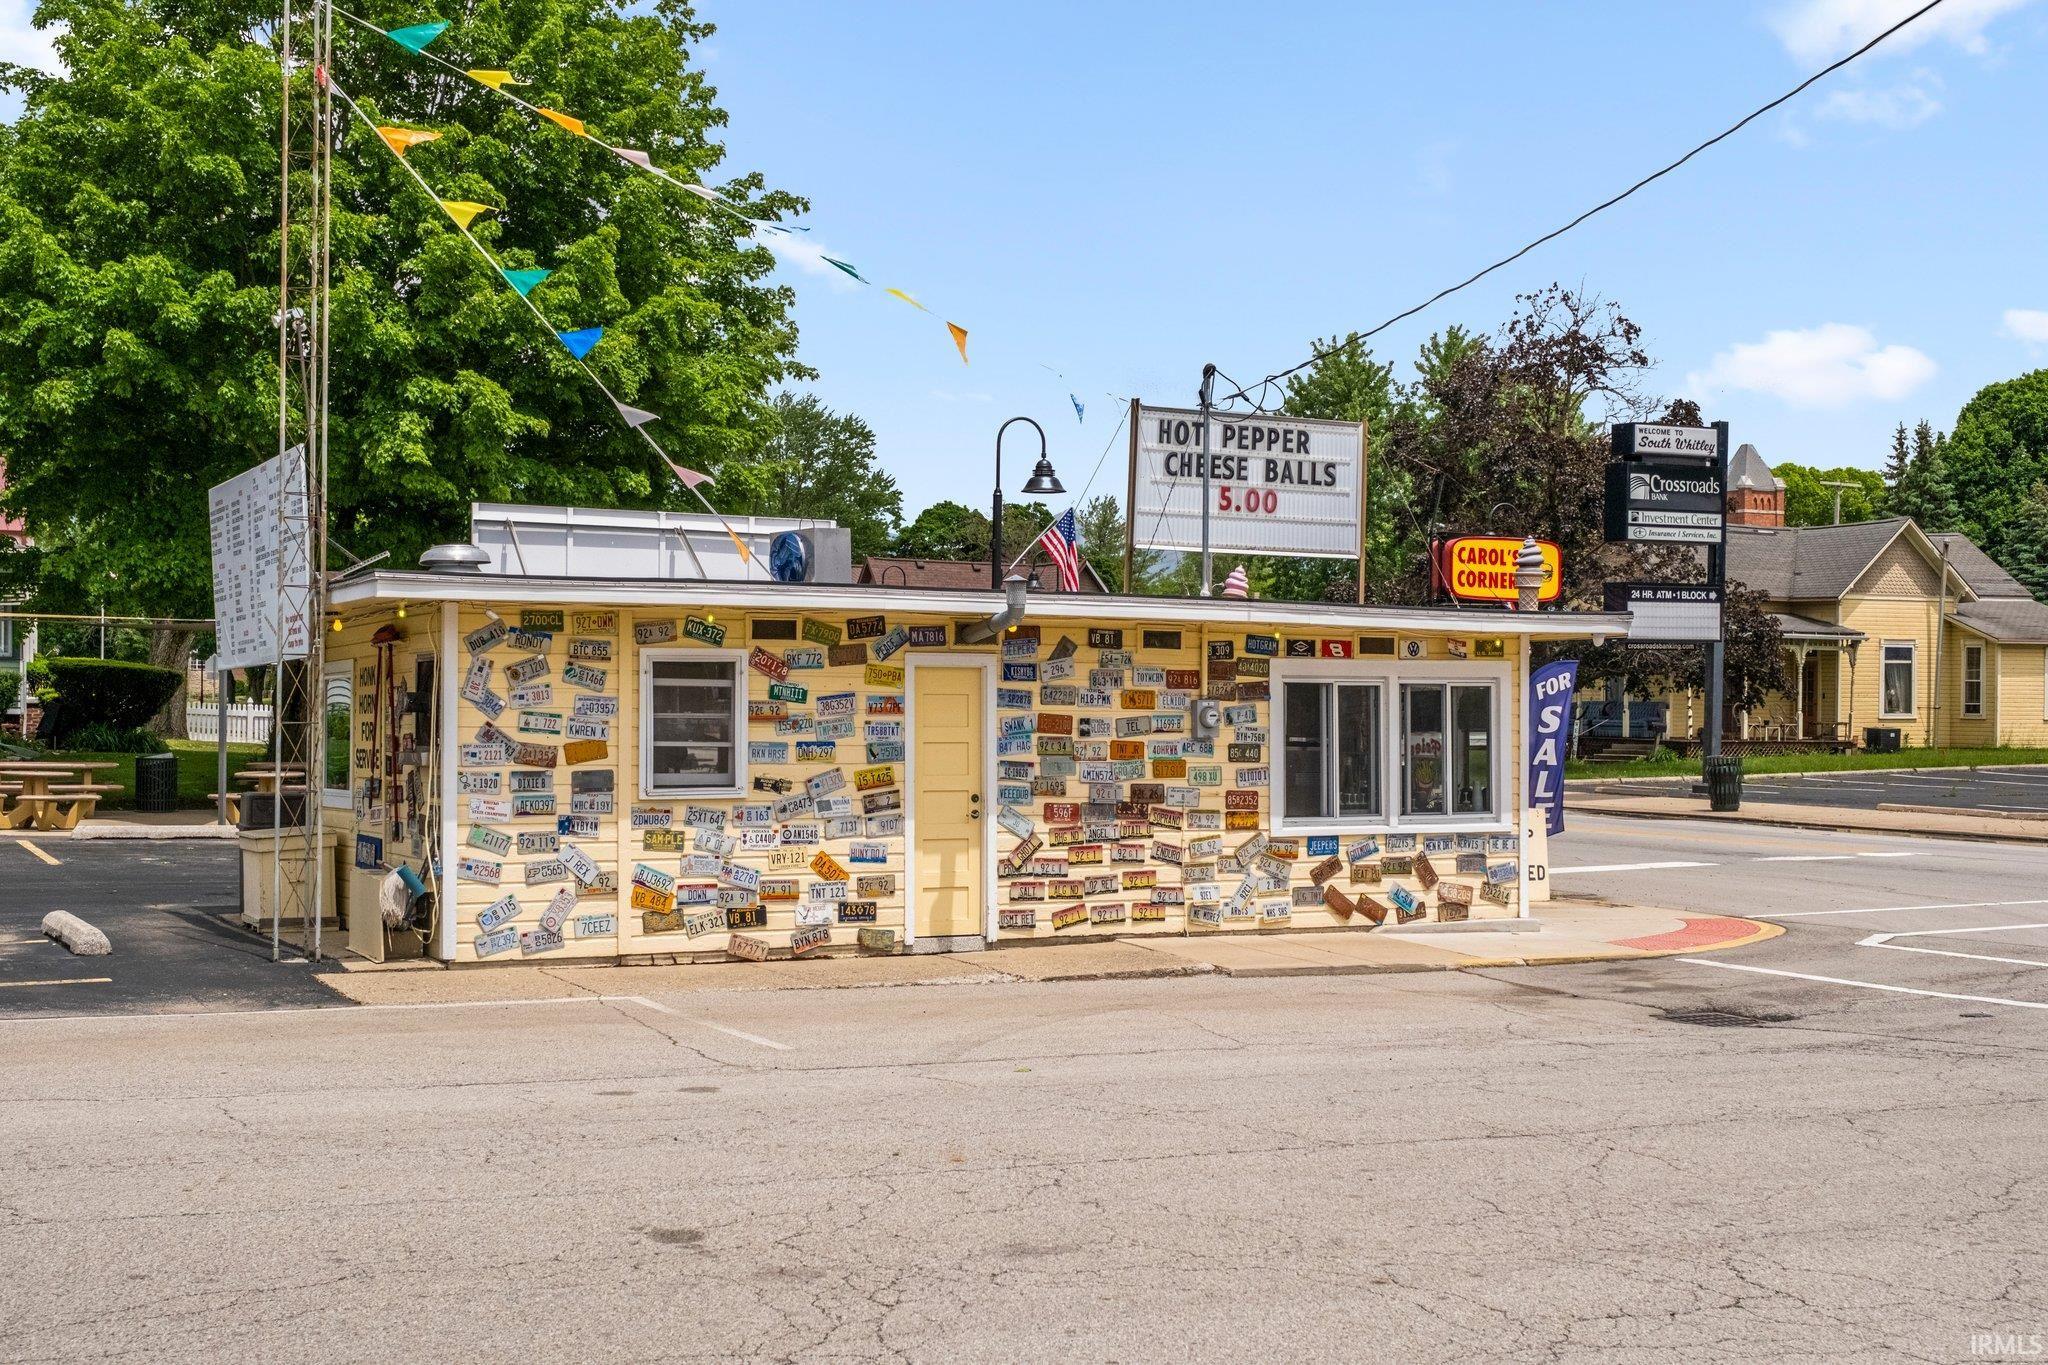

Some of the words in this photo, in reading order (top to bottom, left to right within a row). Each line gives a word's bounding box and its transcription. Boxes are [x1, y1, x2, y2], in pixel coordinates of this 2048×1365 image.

[1158, 419, 1204, 446] HOT
[1222, 424, 1310, 454] PEPPER
[1639, 437, 1671, 449] South
[1675, 438, 1716, 455] Whitley
[1164, 452, 1248, 481] CHEESE
[1265, 458, 1337, 486] BALLS
[1650, 474, 1720, 494] Crossroads
[1219, 486, 1278, 513] 5.00
[1651, 493, 1668, 501] BANK
[1642, 513, 1688, 524] Investment
[1691, 514, 1718, 525] Center
[1649, 530, 1676, 538] Insurance
[1708, 531, 1717, 539] Inc.
[1457, 546, 1519, 567] CAROL'S
[1457, 569, 1515, 590] CORNER
[1631, 590, 1640, 598] 24
[1642, 590, 1654, 599] HR.
[1656, 591, 1672, 599] ATM
[1682, 591, 1706, 599] BLOCK
[576, 616, 592, 628] 927
[573, 645, 588, 655] BTC
[591, 646, 608, 656] 855
[806, 653, 822, 665] 772
[360, 665, 376, 687] HONK
[1536, 672, 1571, 700] FOR
[359, 694, 376, 714] HORN
[645, 834, 684, 845] SAMPLE
[1309, 840, 1338, 850] JEEPERS
[573, 861, 591, 878] REX
